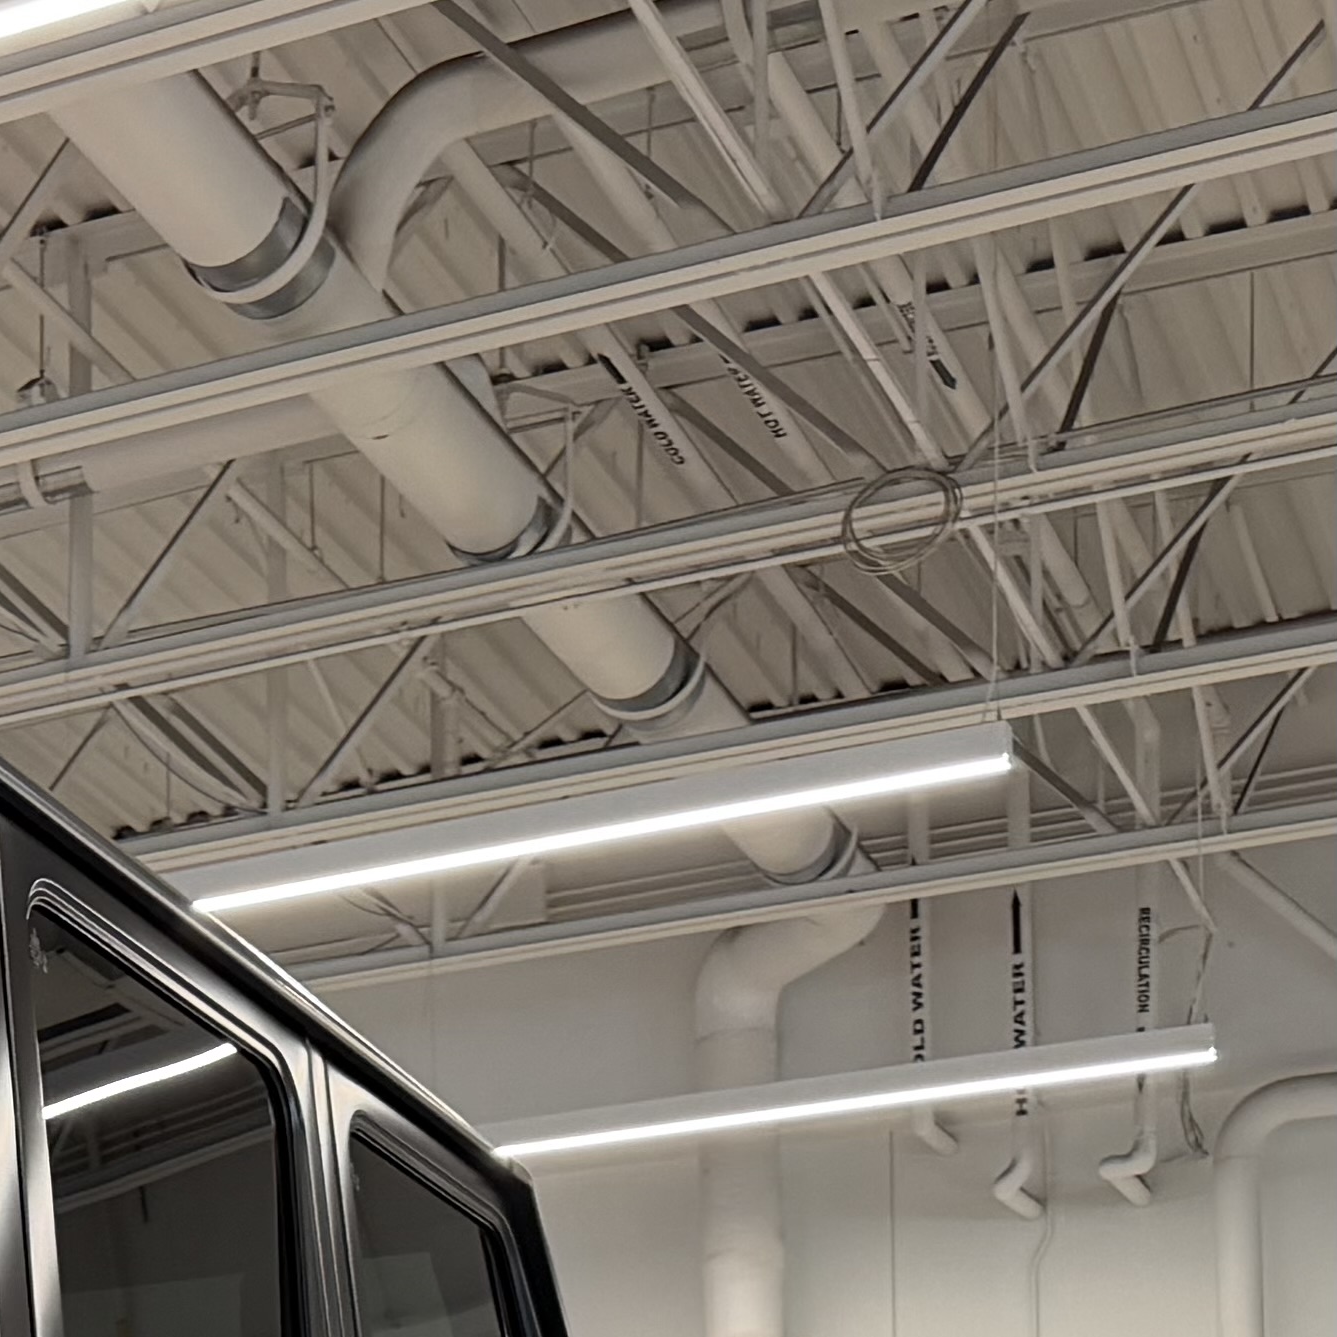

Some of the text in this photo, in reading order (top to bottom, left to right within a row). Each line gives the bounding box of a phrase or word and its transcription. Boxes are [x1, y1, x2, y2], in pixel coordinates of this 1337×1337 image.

[652, 431, 685, 465] COLD
[756, 411, 787, 438] HOT
[910, 926, 924, 1012] WATER
[1137, 907, 1151, 1013] RECIRCULATION
[1012, 962, 1027, 1049] WATER
